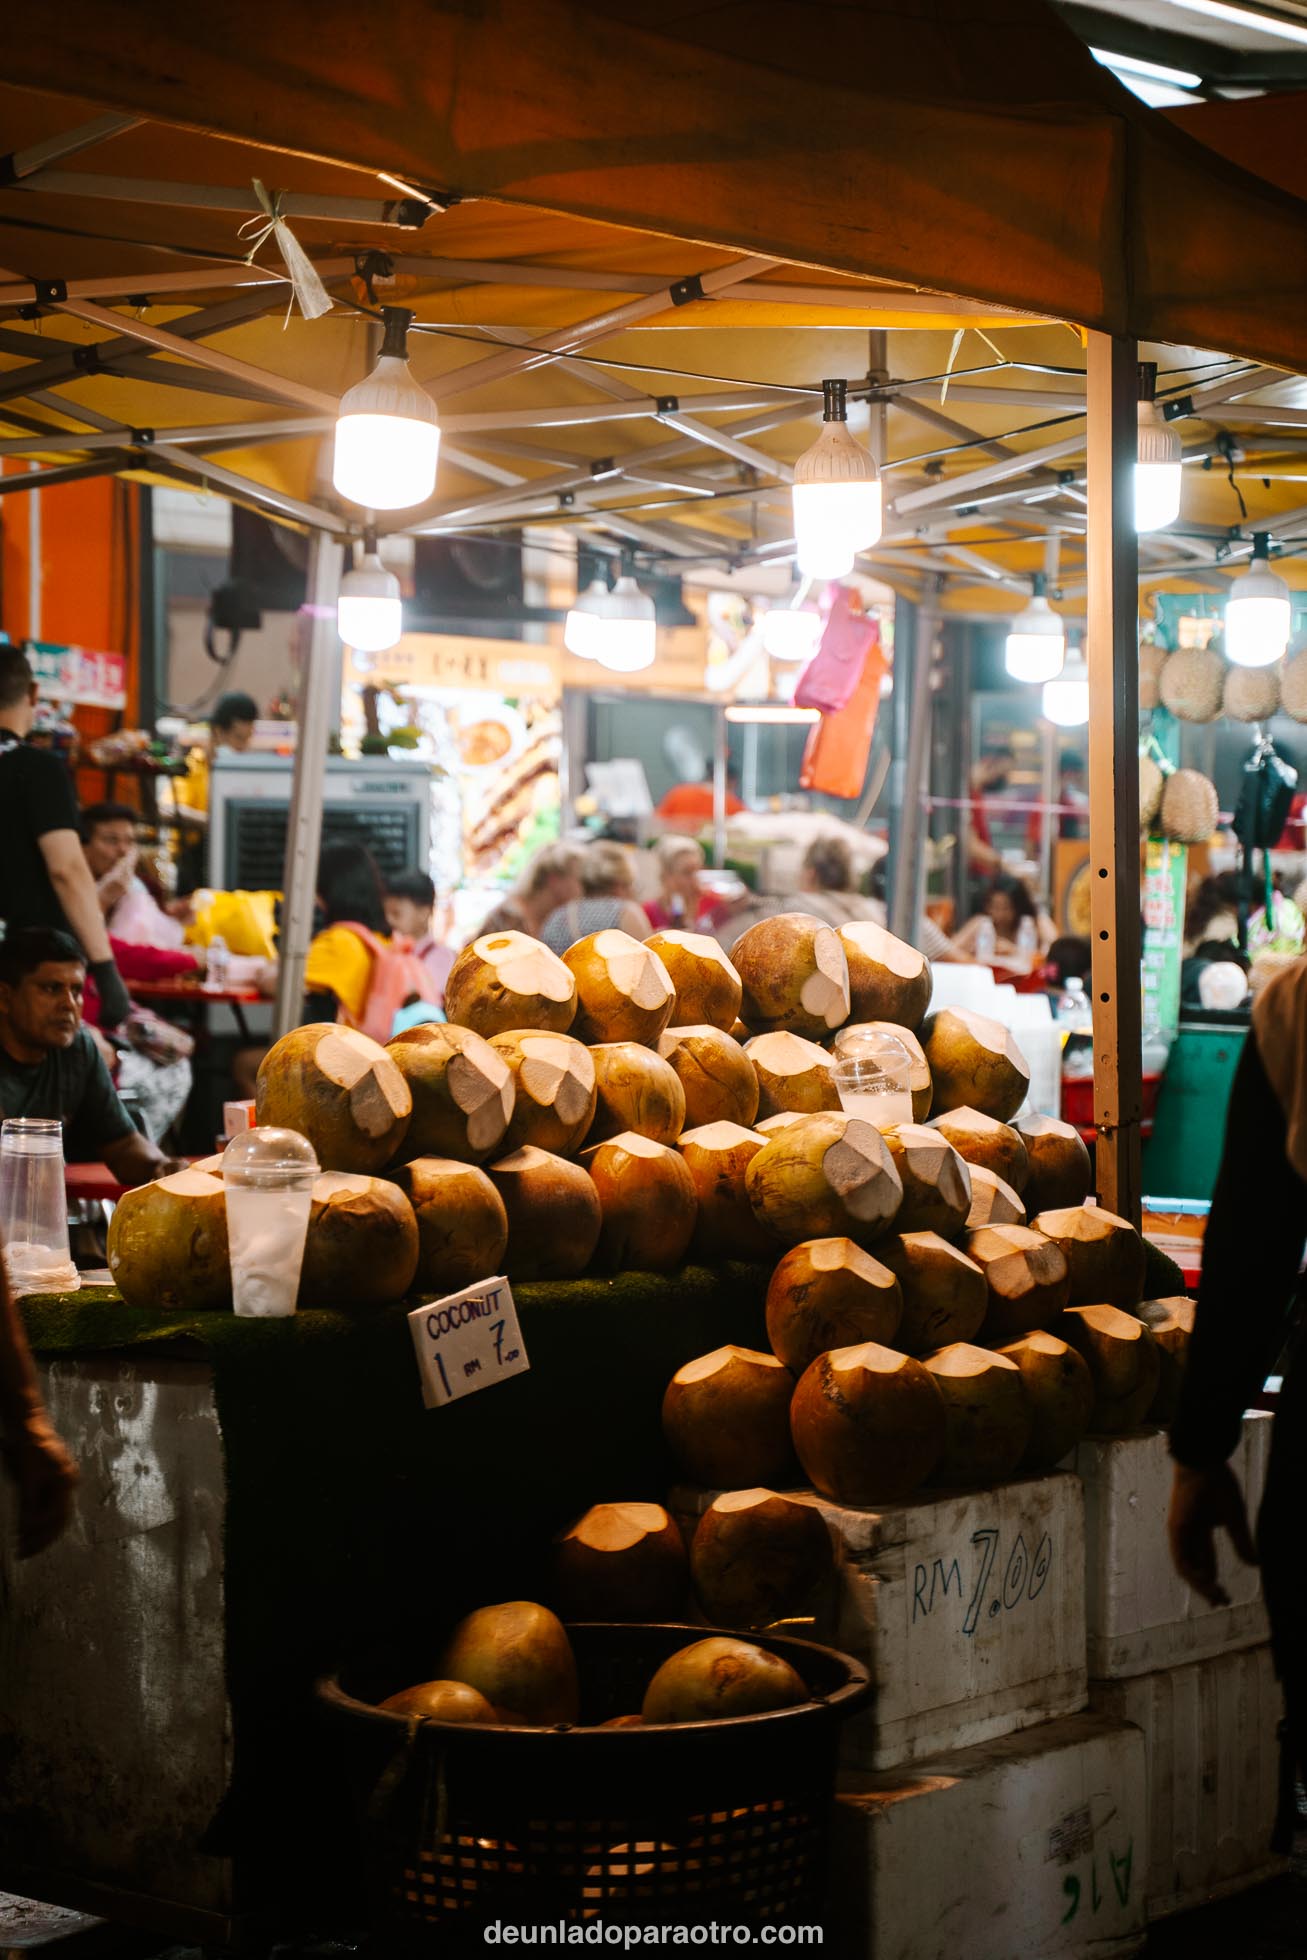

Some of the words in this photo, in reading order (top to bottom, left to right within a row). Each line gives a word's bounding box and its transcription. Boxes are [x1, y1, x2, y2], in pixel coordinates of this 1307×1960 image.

[427, 1289, 502, 1340] COCONUT
[434, 1352, 452, 1397] 1
[463, 1358, 482, 1378] RM
